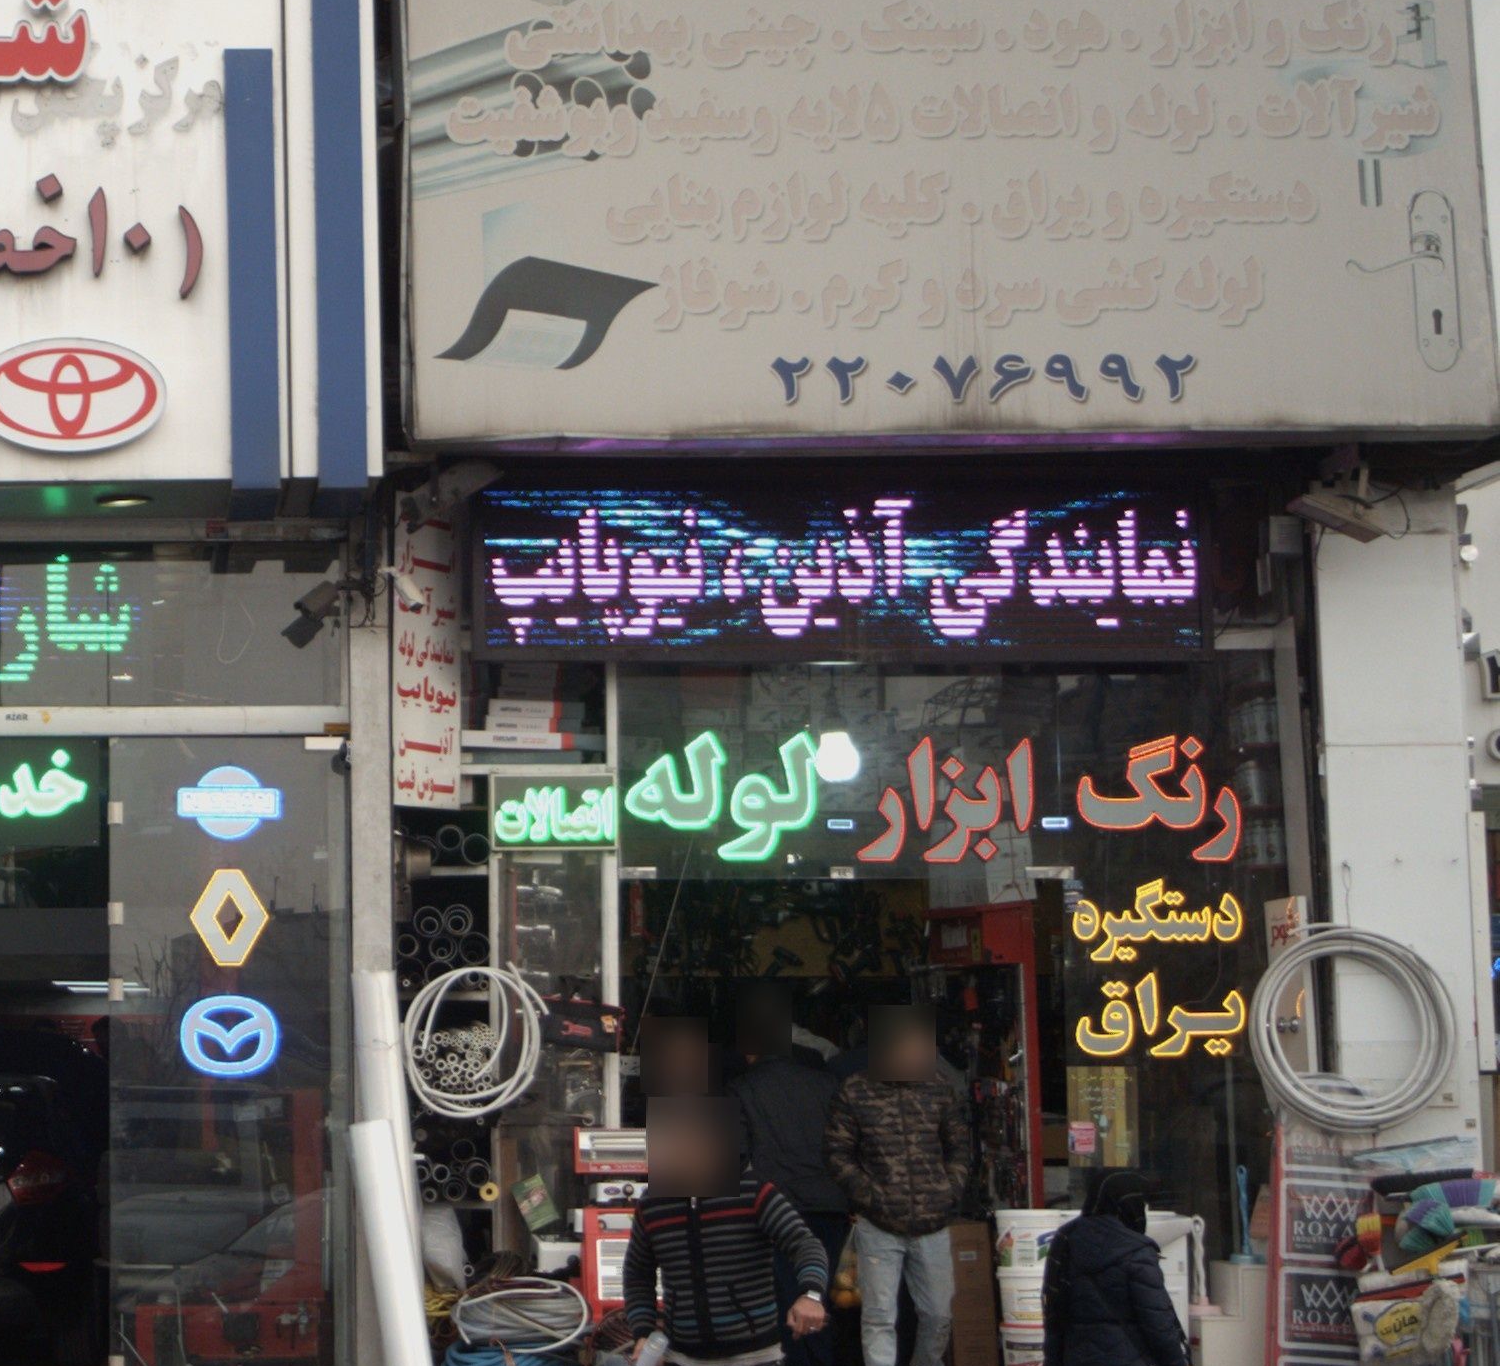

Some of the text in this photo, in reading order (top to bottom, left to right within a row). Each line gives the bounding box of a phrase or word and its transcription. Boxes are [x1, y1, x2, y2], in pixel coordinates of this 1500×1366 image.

[504, 0, 692, 68] بهداشتی
[1022, 7, 1110, 67] هود
[1263, 19, 1292, 66] و
[910, 82, 1081, 140] اتصالات
[1089, 104, 1119, 153] و
[1125, 82, 1216, 153] لوله
[1256, 76, 1362, 139] آلات
[1362, 85, 1442, 153] شیر
[730, 170, 850, 242] لوازم
[991, 168, 1094, 242] یراق
[1103, 189, 1135, 240] و
[1138, 169, 1320, 239] دستگیره
[1174, 254, 1267, 327] لوله
[770, 351, 1200, 404] ۲۲۰۷۶۹۹۲
[928, 507, 1197, 638] نمایندگی
[623, 730, 1242, 864] لوله ابزار رنگ
[1071, 878, 1244, 962] دستگیره
[1074, 971, 1247, 1059] یراق
[1293, 1220, 1355, 1238] ROYA
[1292, 1308, 1351, 1326] ROYA
